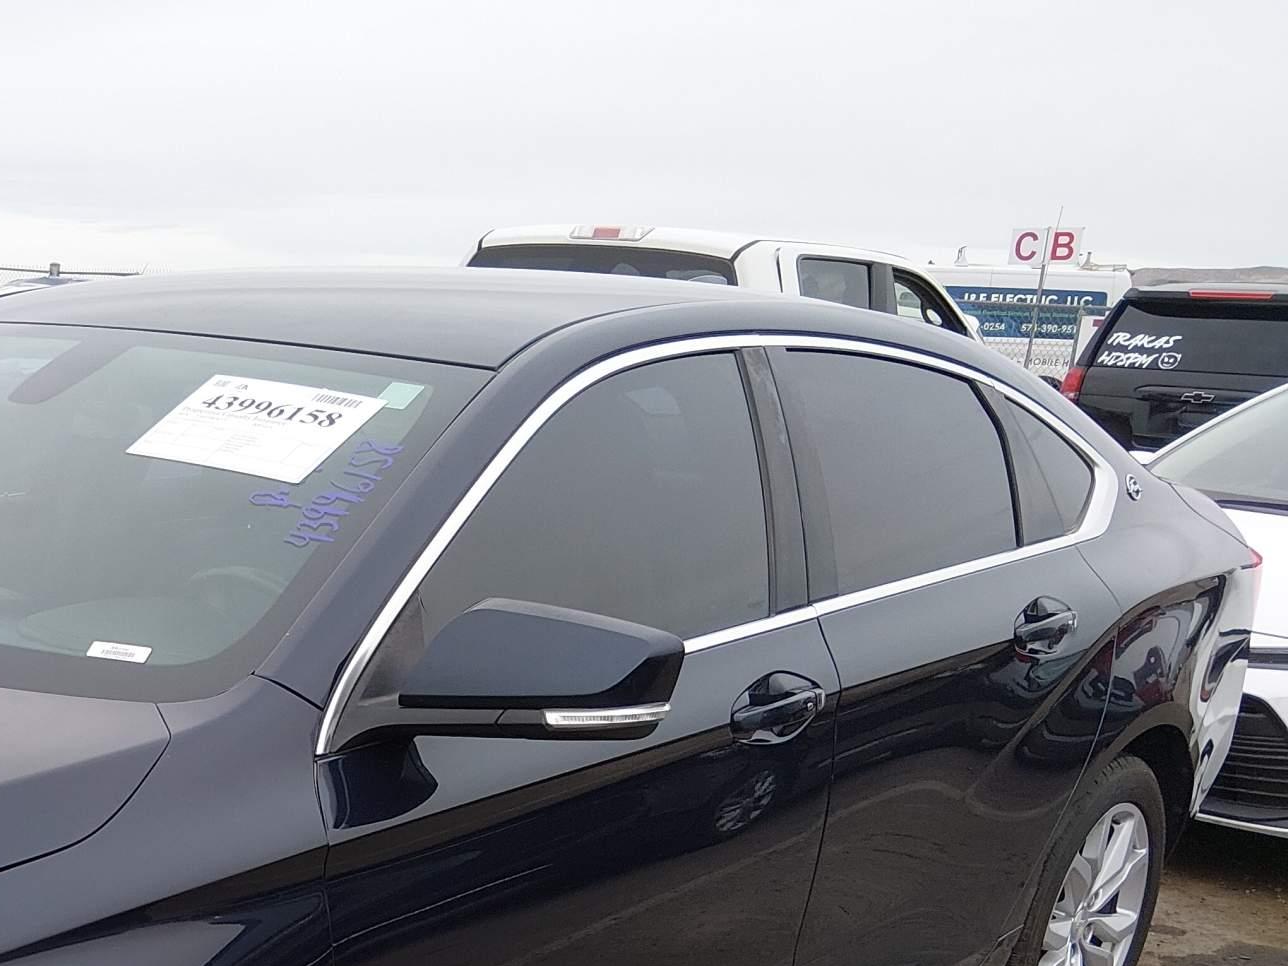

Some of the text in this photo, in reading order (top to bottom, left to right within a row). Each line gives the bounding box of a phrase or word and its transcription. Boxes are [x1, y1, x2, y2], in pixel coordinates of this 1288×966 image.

[1015, 232, 1075, 261] C B
[202, 394, 343, 428] 43996158
